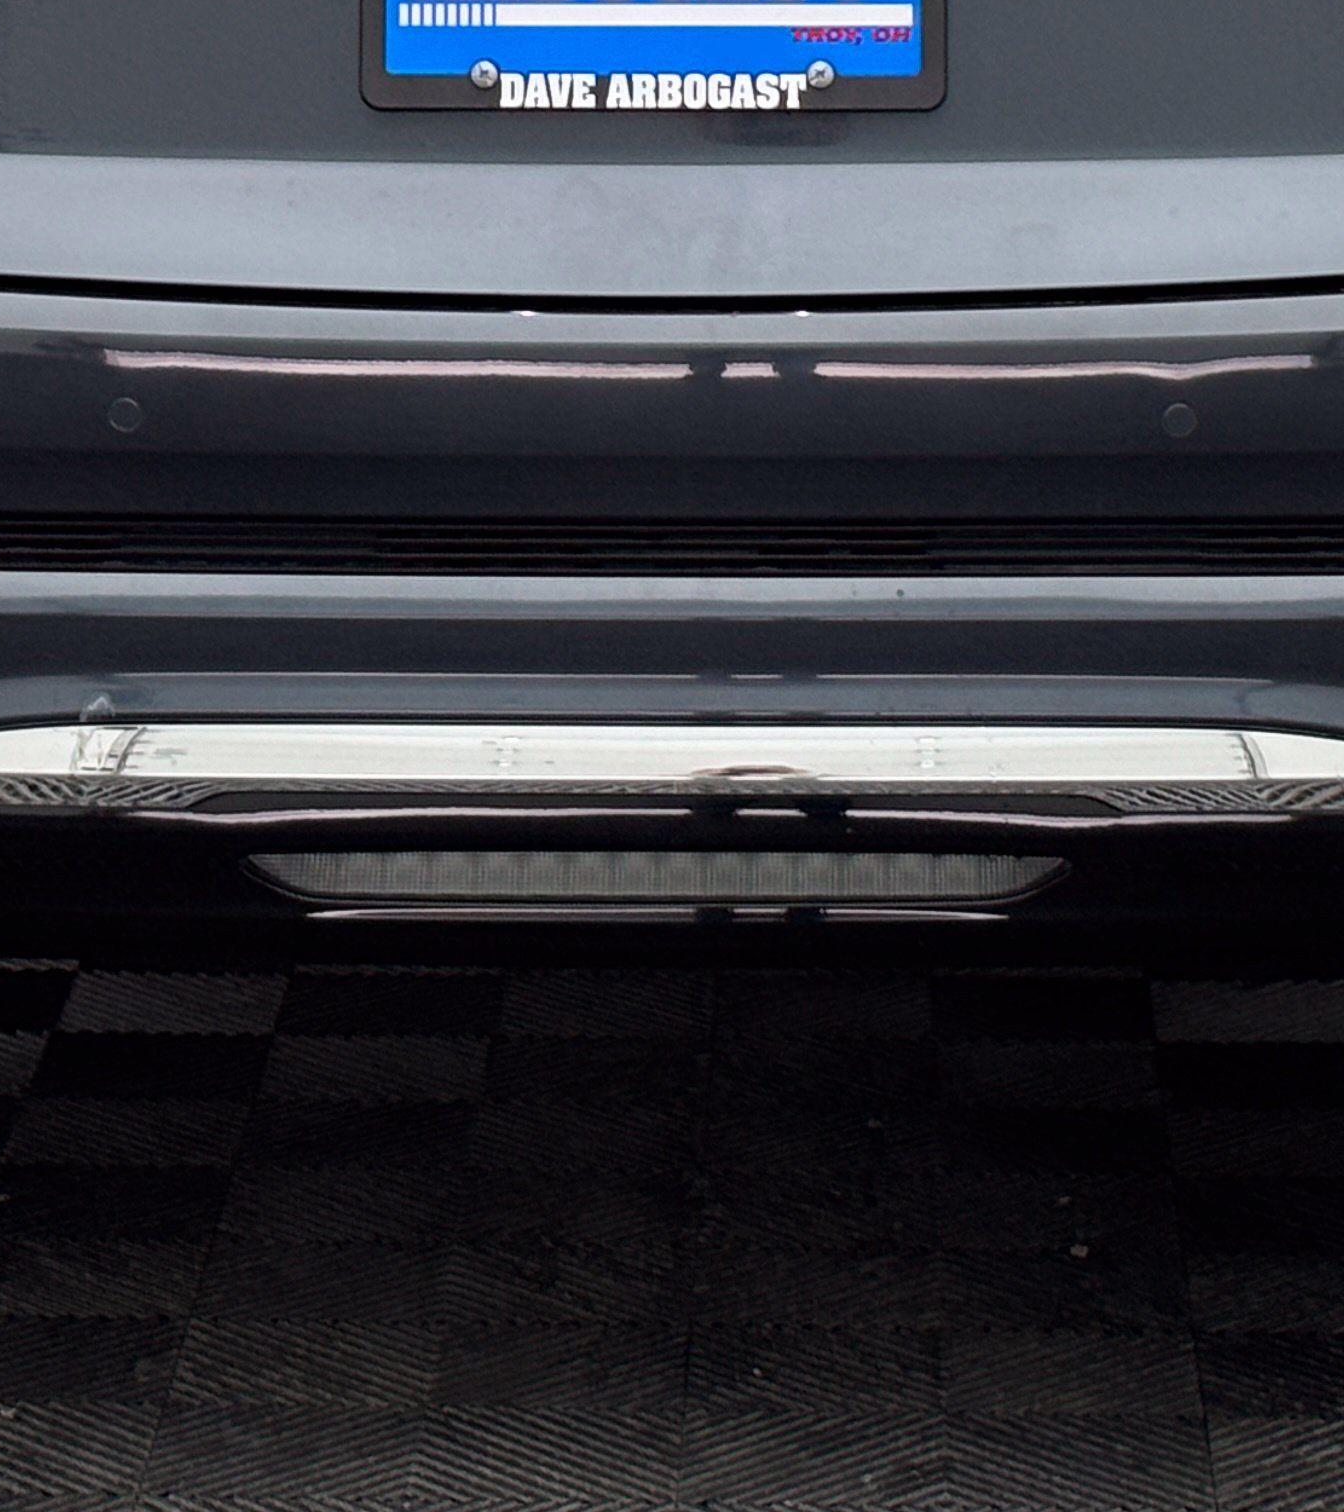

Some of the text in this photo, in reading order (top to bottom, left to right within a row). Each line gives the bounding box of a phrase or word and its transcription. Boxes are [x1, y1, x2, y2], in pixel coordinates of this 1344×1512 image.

[792, 27, 911, 45] TROY, OH
[500, 73, 806, 109] DAVE ARBOGAST
